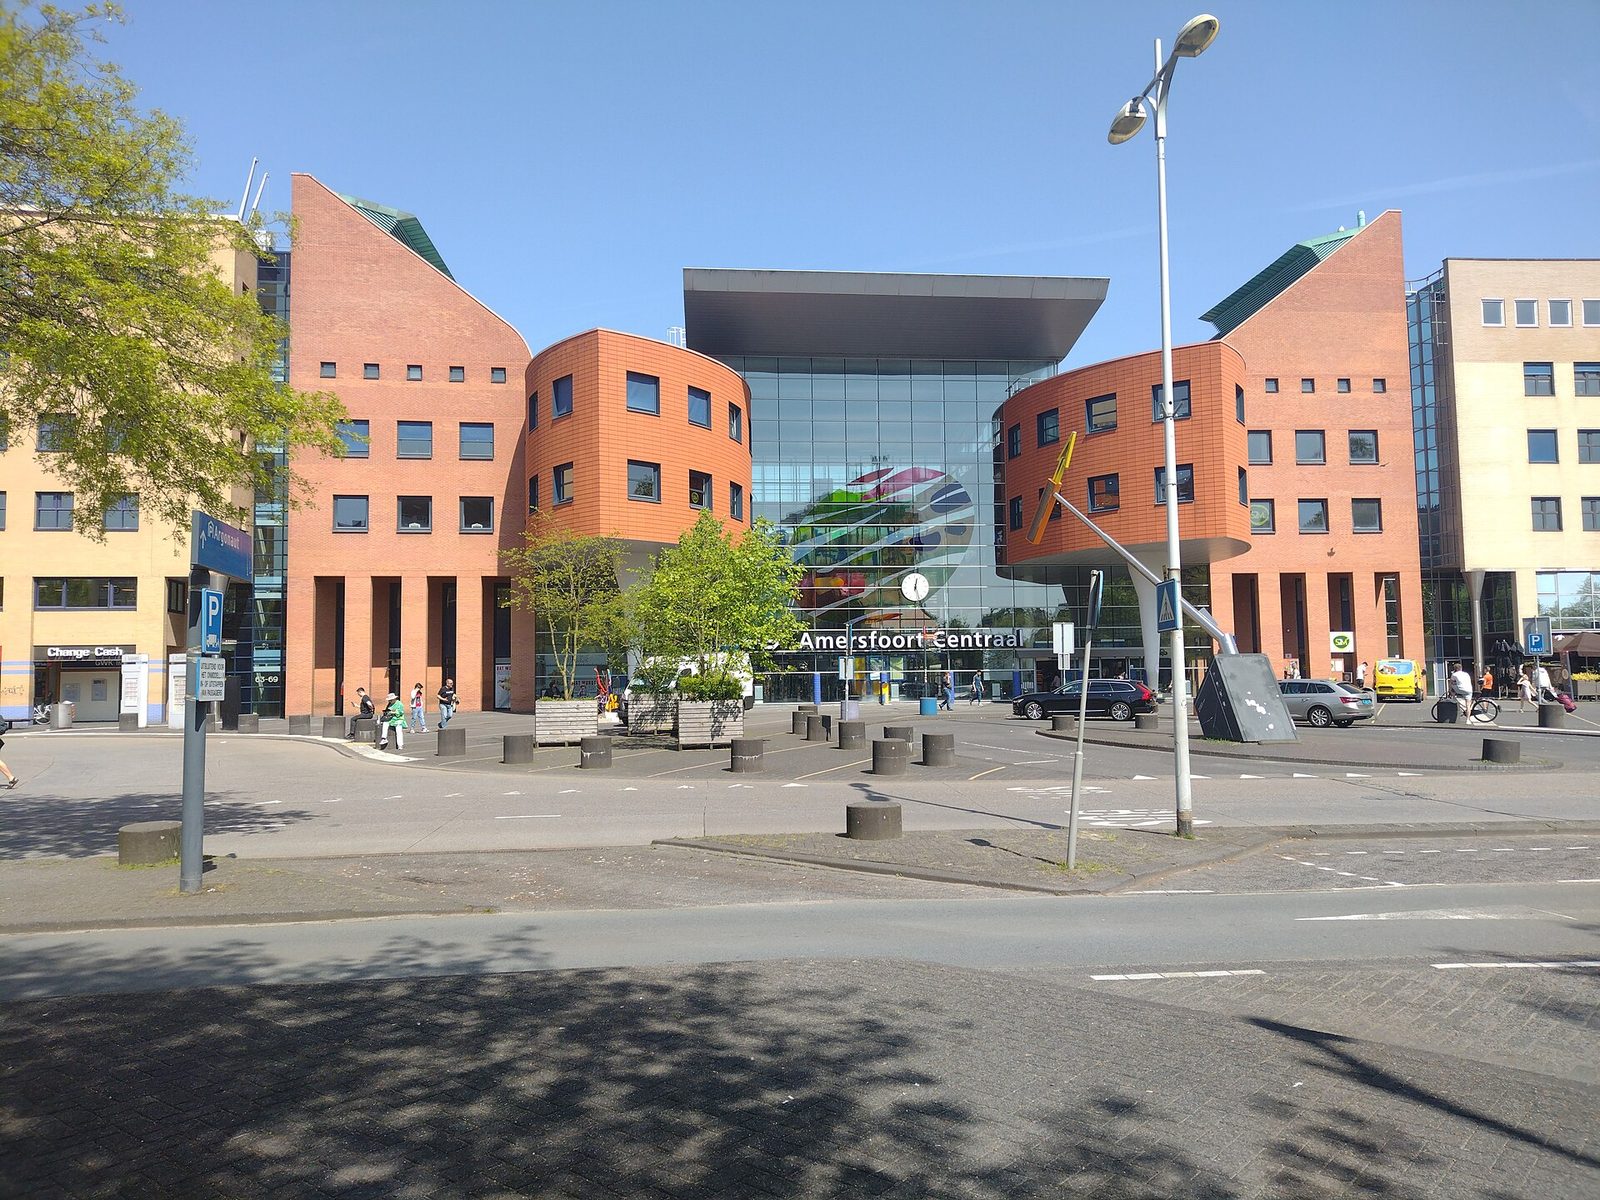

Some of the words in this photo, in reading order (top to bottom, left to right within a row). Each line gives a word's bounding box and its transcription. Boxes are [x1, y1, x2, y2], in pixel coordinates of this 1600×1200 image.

[214, 525, 240, 550] Argonaut
[208, 595, 219, 626] P
[800, 630, 924, 650] Amersfoort
[932, 629, 1024, 649] Centraal
[1531, 635, 1540, 645] P
[47, 646, 91, 659] Change
[94, 646, 123, 657] Cash
